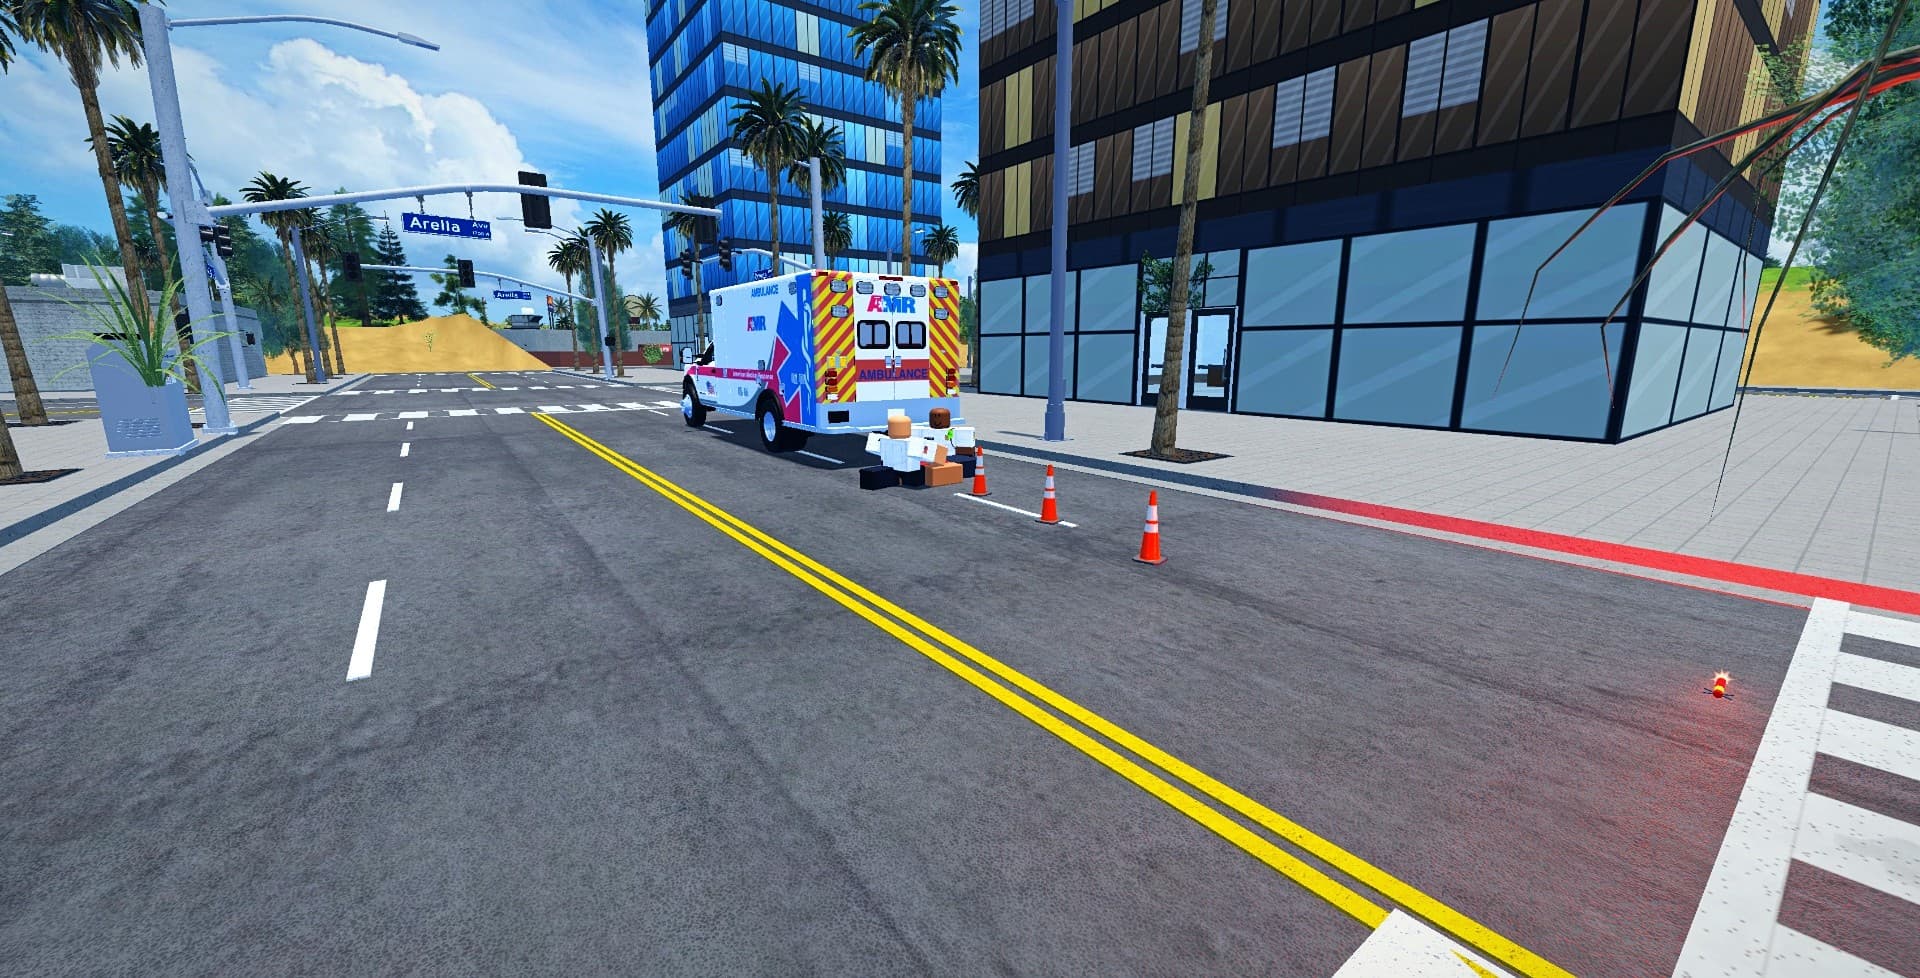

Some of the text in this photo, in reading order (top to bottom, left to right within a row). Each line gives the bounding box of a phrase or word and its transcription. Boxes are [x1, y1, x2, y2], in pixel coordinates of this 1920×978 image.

[410, 216, 461, 233] Arella
[751, 284, 779, 298] AMBULANCE
[867, 295, 916, 313] AMR
[747, 315, 767, 332] AMR
[859, 368, 928, 380] AMBULANCE
